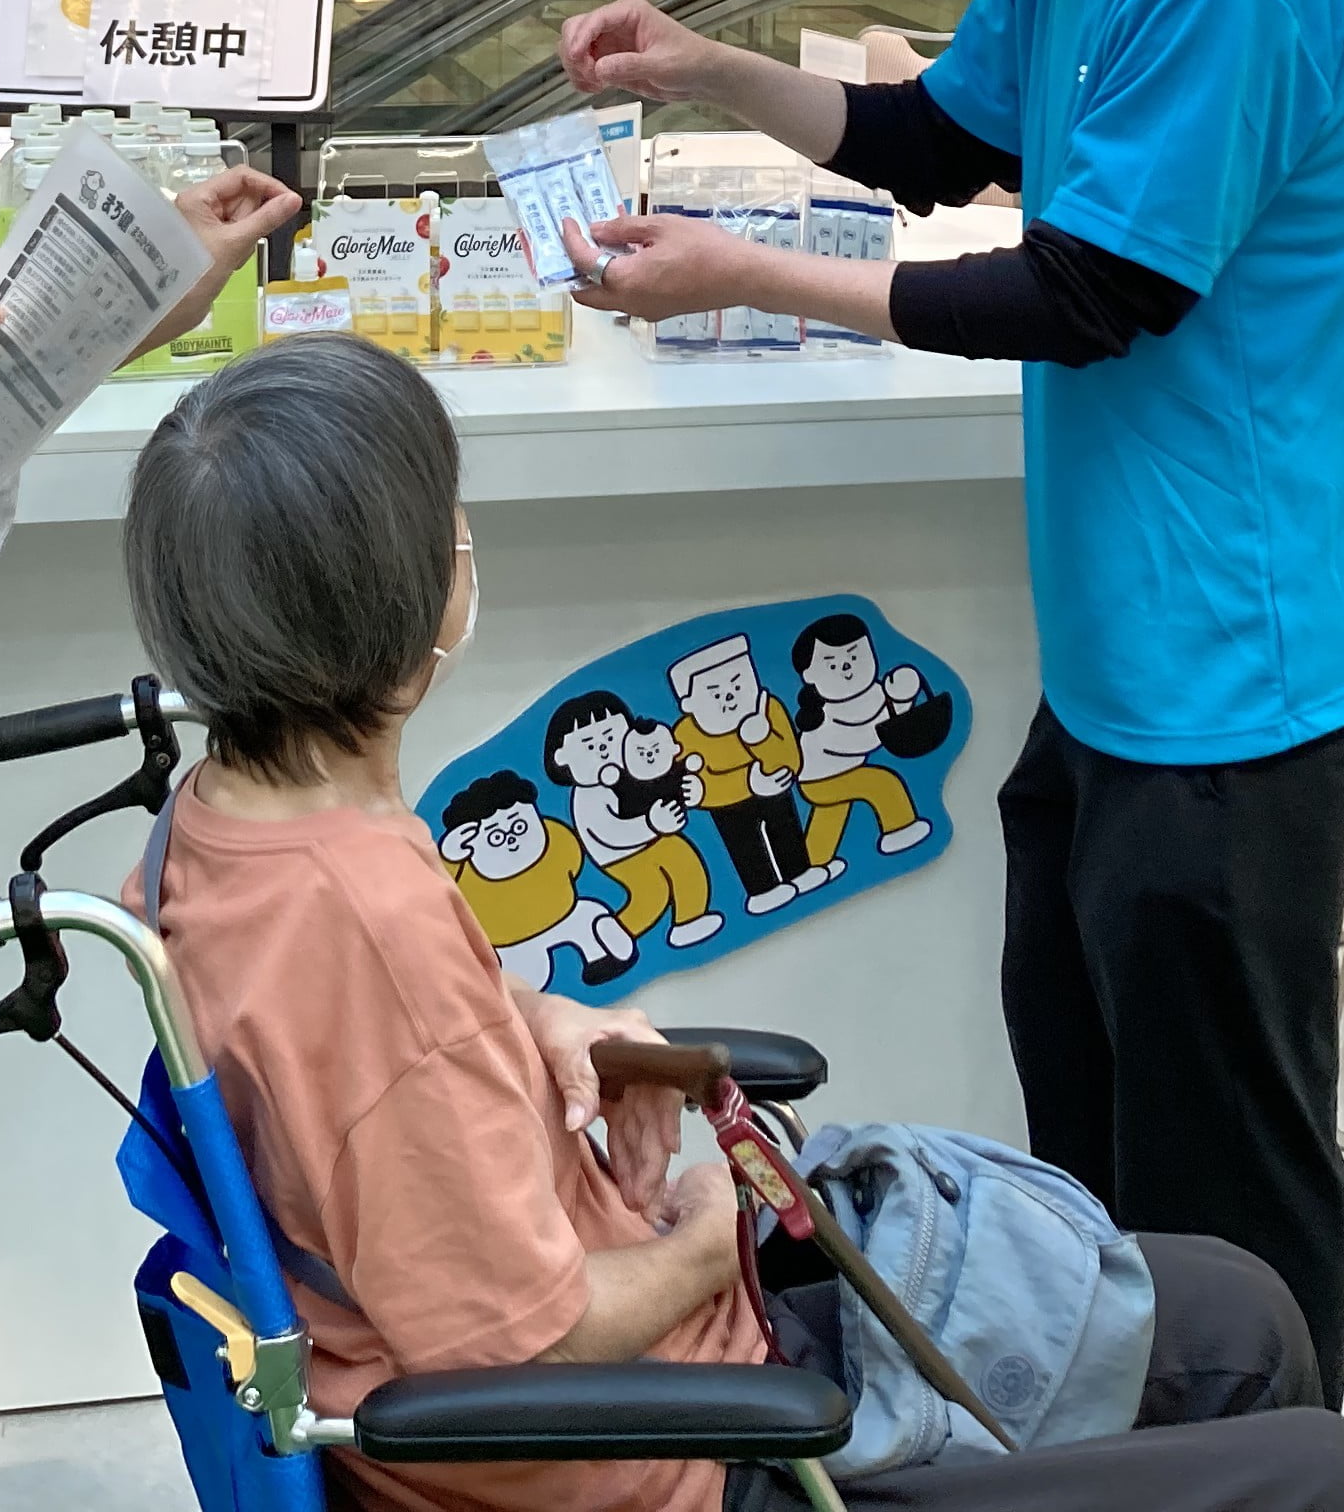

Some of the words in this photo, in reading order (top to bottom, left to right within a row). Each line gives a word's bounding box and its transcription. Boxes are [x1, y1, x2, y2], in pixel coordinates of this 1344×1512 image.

[99, 19, 247, 68] 休憩中
[331, 235, 415, 261] CalorieMate
[170, 337, 233, 353] BODYMAINTE
